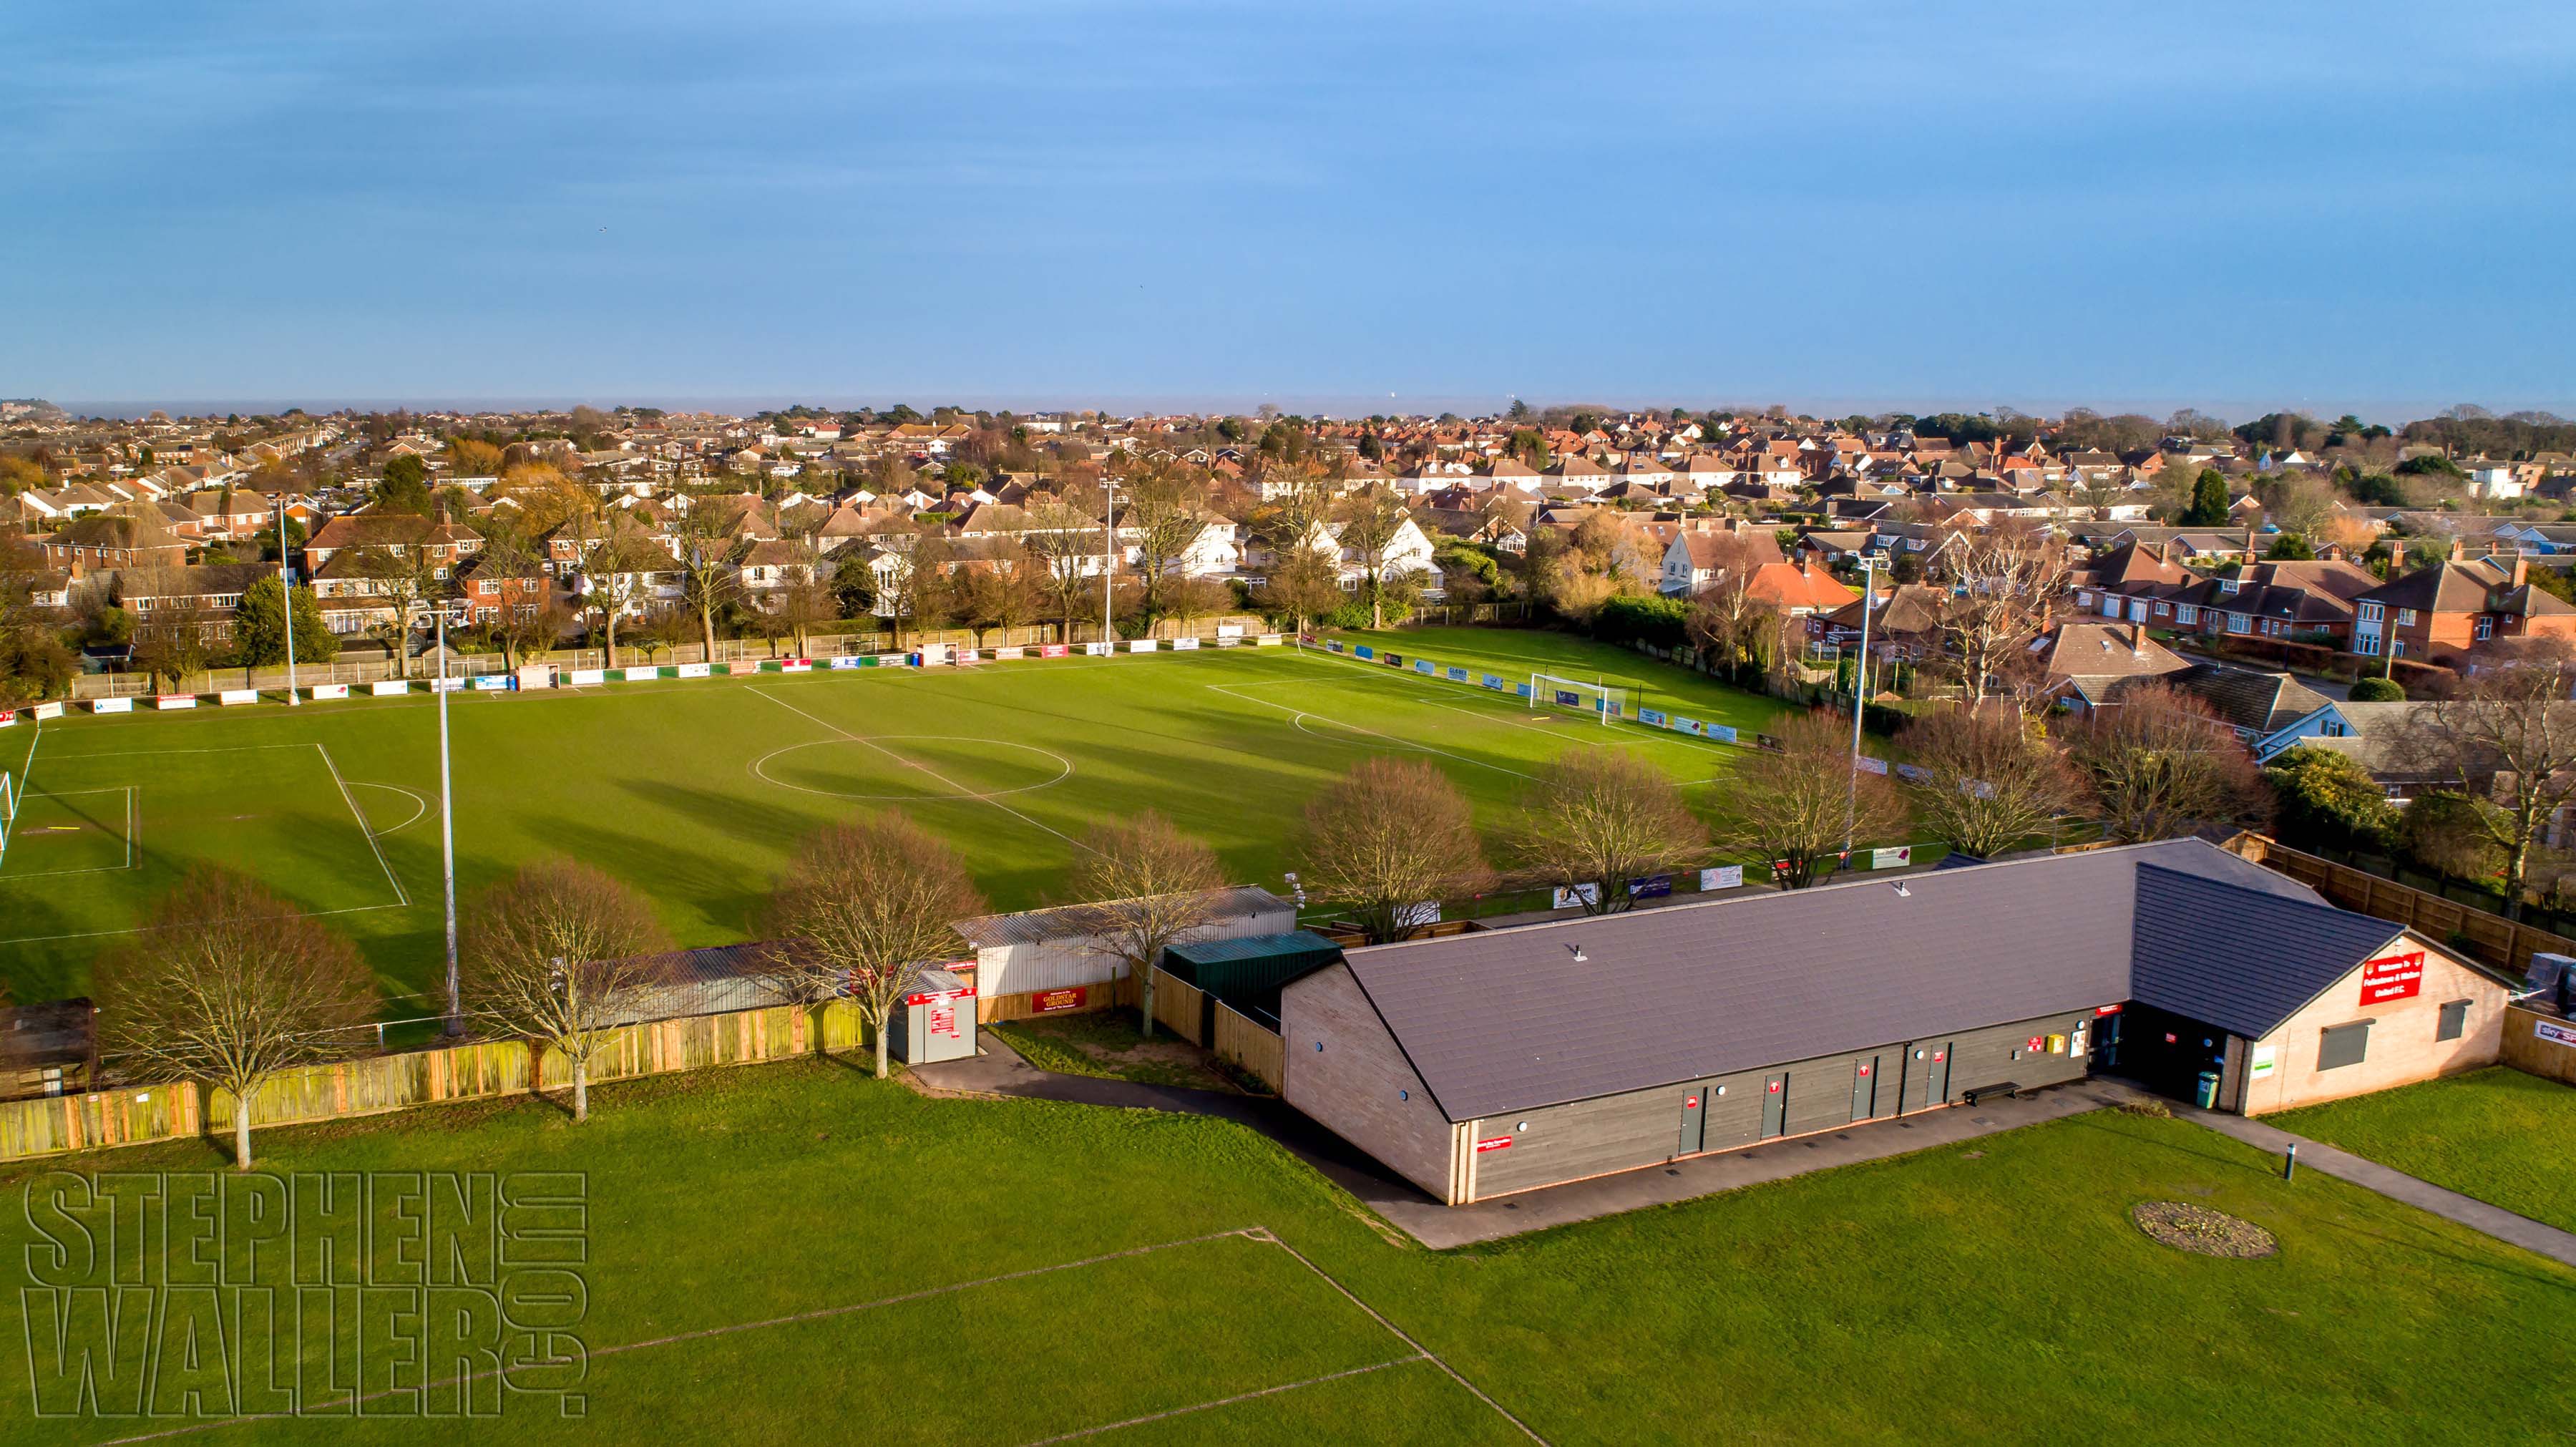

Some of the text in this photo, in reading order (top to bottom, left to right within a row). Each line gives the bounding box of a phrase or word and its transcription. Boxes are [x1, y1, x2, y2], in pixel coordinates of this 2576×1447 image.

[2378, 963, 2403, 972] Welcome
[2375, 988, 2394, 997] United
[1043, 993, 1077, 1003] GOLDSTAR
[2542, 1027, 2560, 1037] sky
